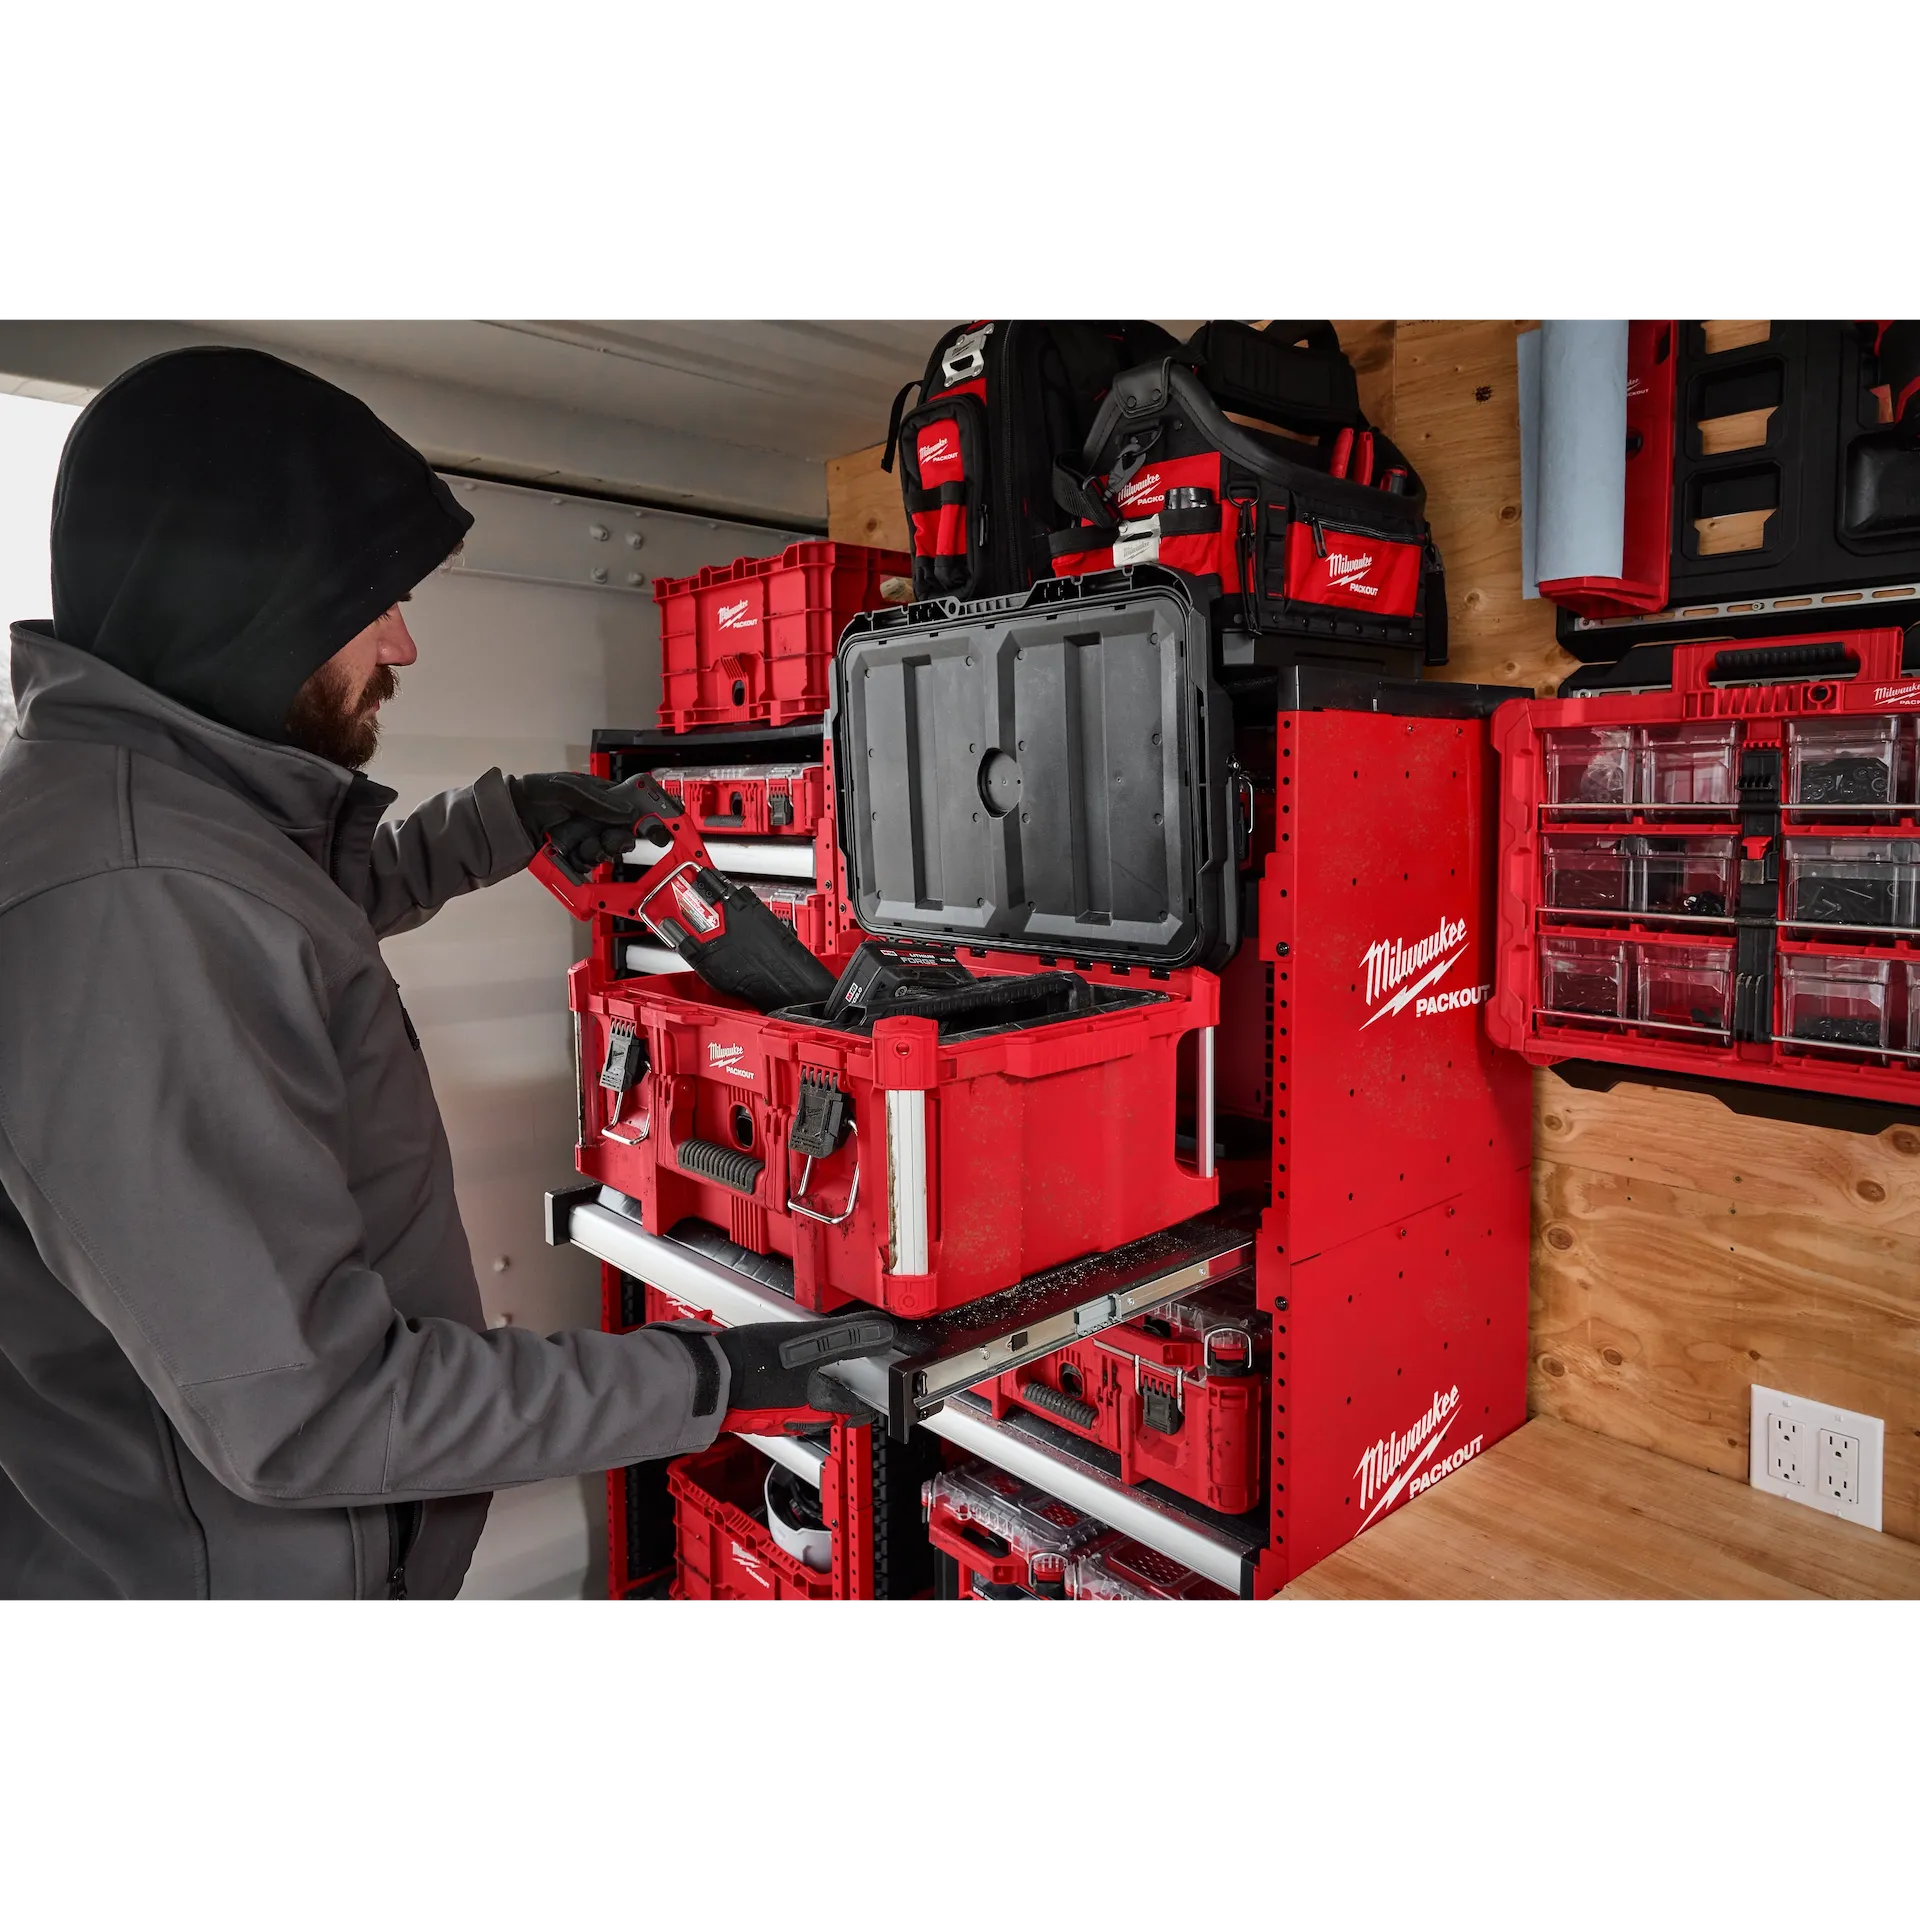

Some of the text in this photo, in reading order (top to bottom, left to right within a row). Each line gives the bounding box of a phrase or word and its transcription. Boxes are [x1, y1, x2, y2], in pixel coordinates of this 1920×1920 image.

[1117, 473, 1161, 503] Milwaukee
[1137, 494, 1165, 506] PACKO
[1324, 552, 1373, 579] Milwaukee
[1349, 582, 1379, 597] PACKOUT
[1873, 682, 1920, 701] Milwauke
[900, 956, 939, 966] FORGE
[1358, 915, 1468, 1007] Milwaukee
[1415, 984, 1491, 1018] PACKOUT
[707, 1041, 745, 1062] Milwaukee
[725, 1065, 755, 1080] PACKOUT
[1353, 1384, 1461, 1511] Milwaukee
[1409, 1433, 1484, 1500] PACKOUT
